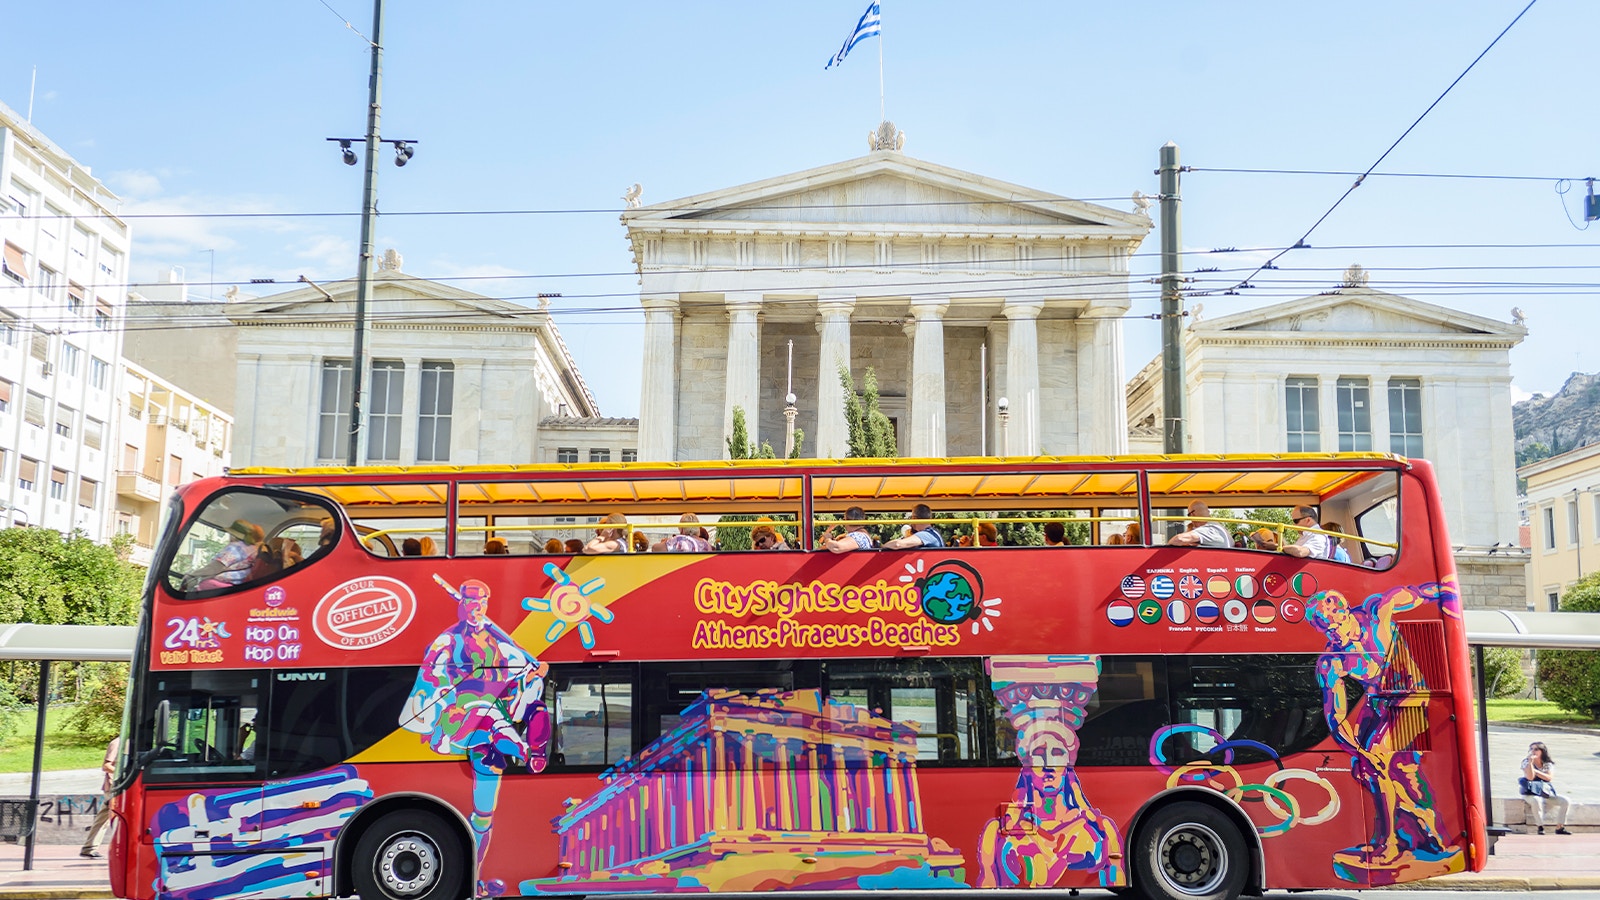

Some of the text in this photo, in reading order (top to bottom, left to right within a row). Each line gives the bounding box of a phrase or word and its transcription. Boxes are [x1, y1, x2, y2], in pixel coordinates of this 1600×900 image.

[342, 580, 375, 595] TOUR
[332, 600, 397, 625] OFFICIAL
[163, 617, 201, 649] 24
[245, 624, 299, 643] Hop On
[340, 625, 397, 646] OF ATHENS
[160, 649, 224, 665] Valid Ticket
[244, 644, 301, 662] Hop Off
[277, 672, 326, 681] UNVI
